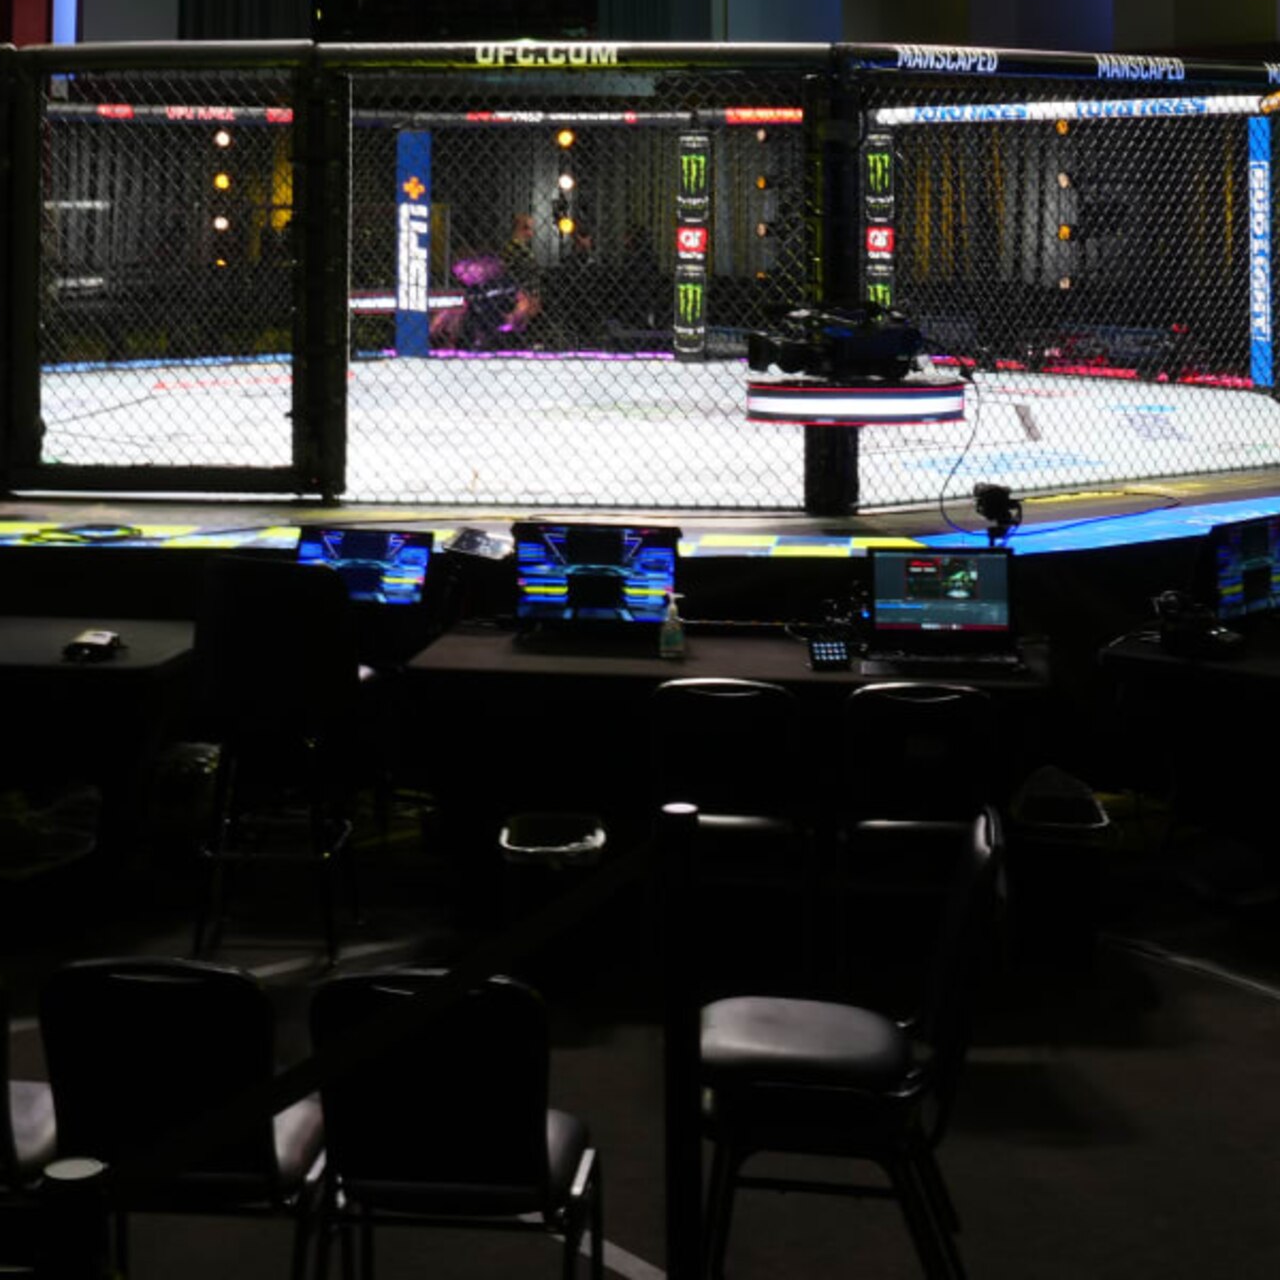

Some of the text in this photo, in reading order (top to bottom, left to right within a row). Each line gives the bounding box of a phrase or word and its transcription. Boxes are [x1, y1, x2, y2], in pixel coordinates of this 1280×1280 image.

[474, 45, 619, 65] UFC.COM
[895, 45, 999, 72] MANSCAPED
[1094, 53, 1185, 81] MANSCAPED
